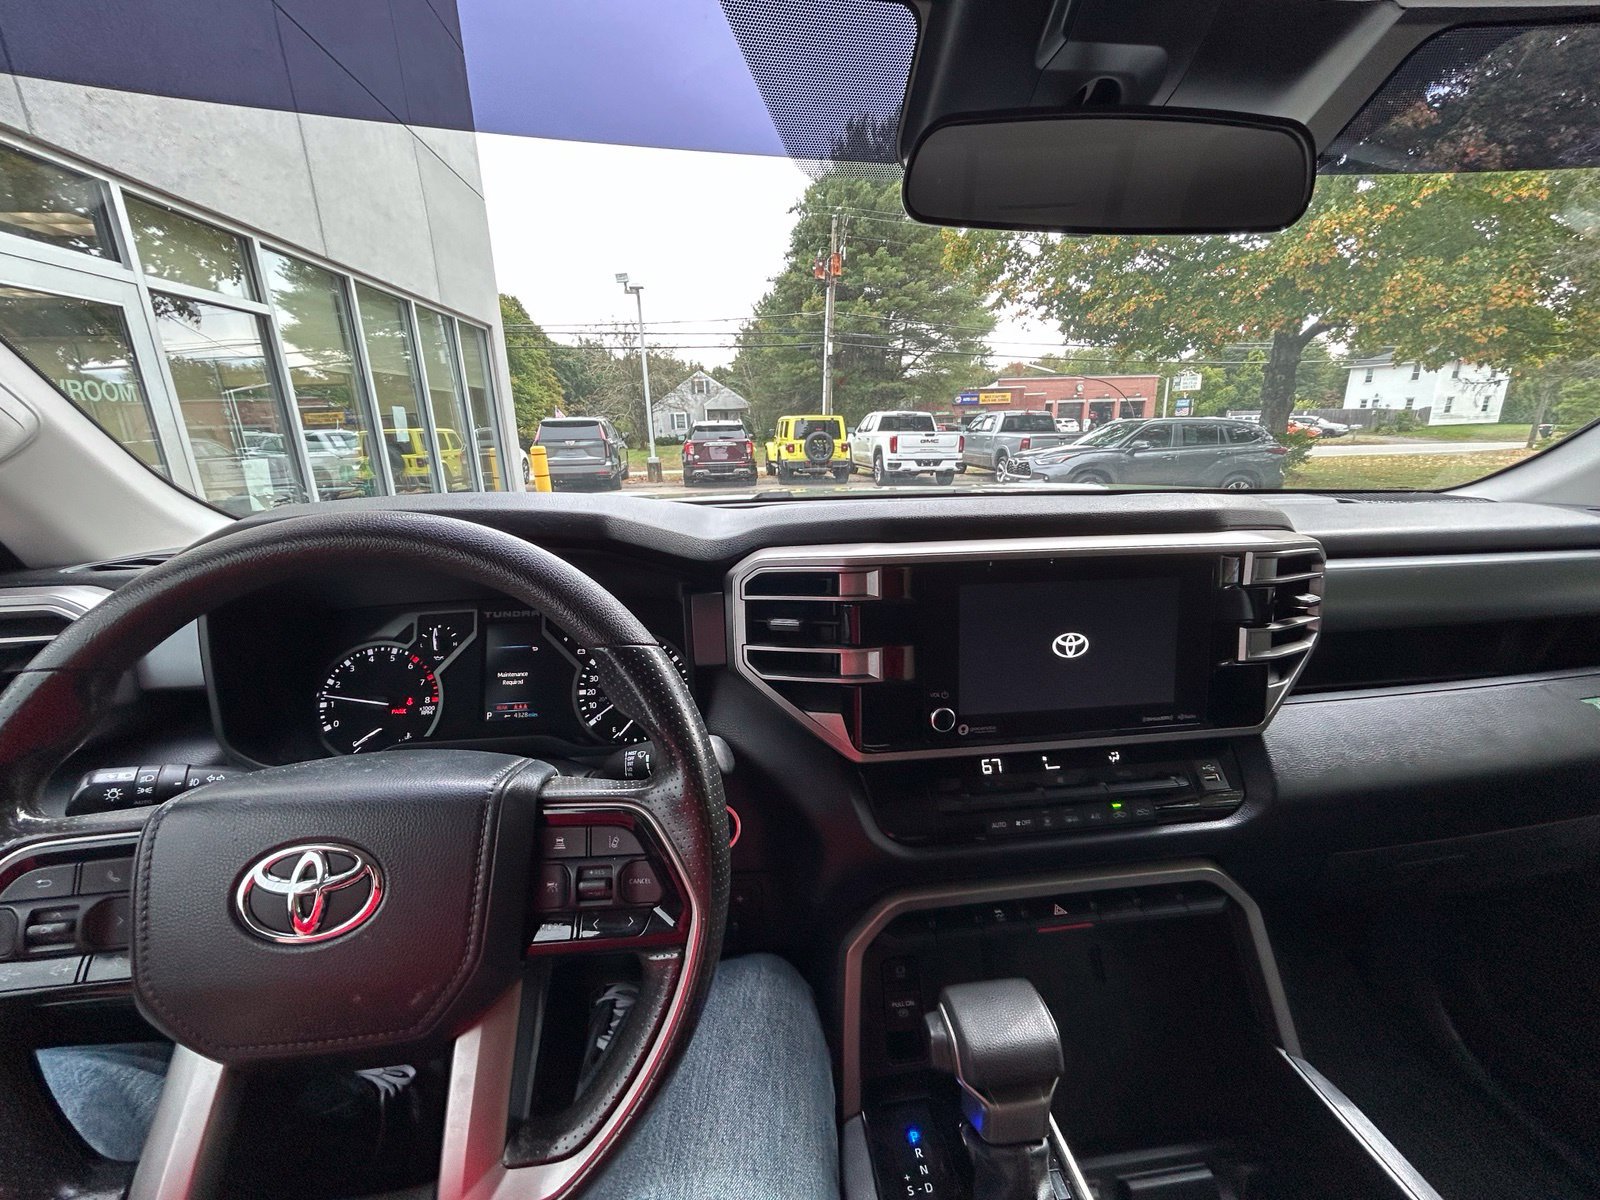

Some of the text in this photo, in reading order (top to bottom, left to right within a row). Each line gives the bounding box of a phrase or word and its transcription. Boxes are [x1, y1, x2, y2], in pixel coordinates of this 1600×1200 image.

[60, 379, 137, 402] ROOM
[484, 610, 540, 618] TUNDRA
[486, 712, 492, 720] P
[981, 758, 1002, 775] 67
[910, 1131, 918, 1144] P
[914, 1148, 924, 1158] R
[919, 1164, 929, 1175] N
[907, 1182, 933, 1196] S D
